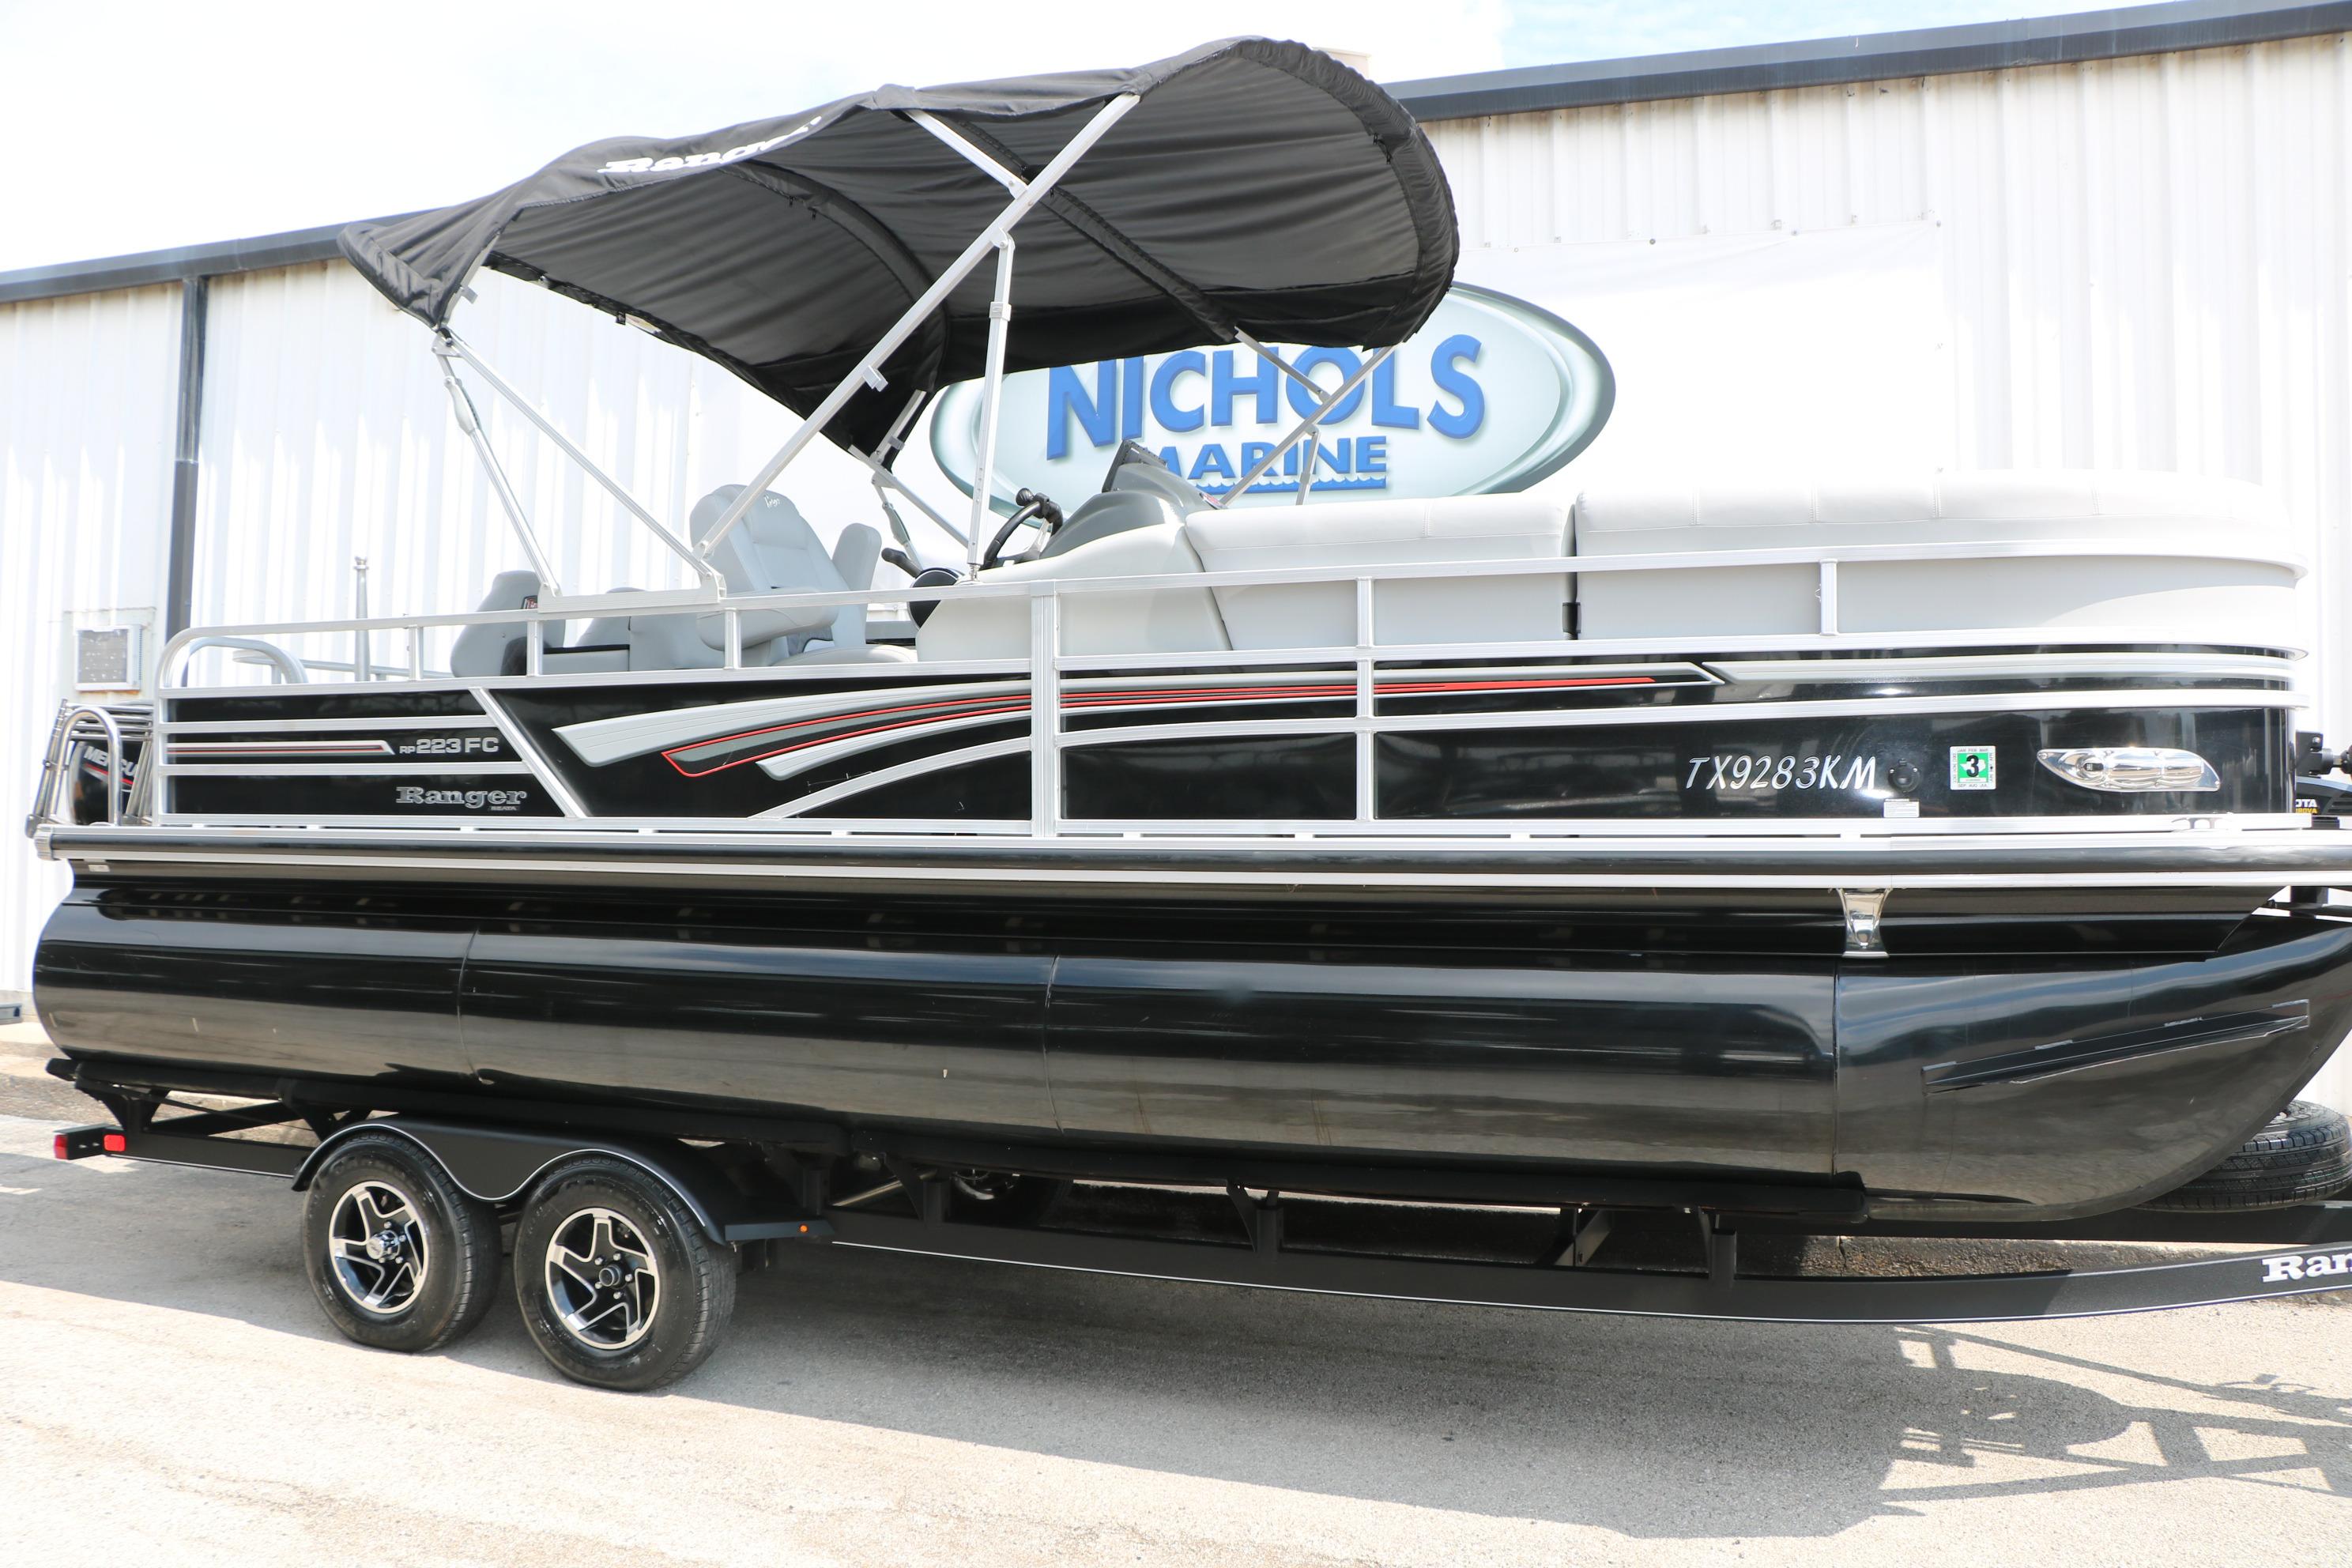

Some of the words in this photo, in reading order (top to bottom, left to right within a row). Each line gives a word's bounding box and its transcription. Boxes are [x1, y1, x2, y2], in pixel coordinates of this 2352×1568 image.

[1046, 334, 1485, 461] NICHOLS
[84, 745, 138, 776] MECU
[1686, 755, 1876, 790] TX9283KM
[1966, 755, 1979, 778] 3
[395, 786, 528, 808] Ranger
[2295, 798, 2318, 808] OTA
